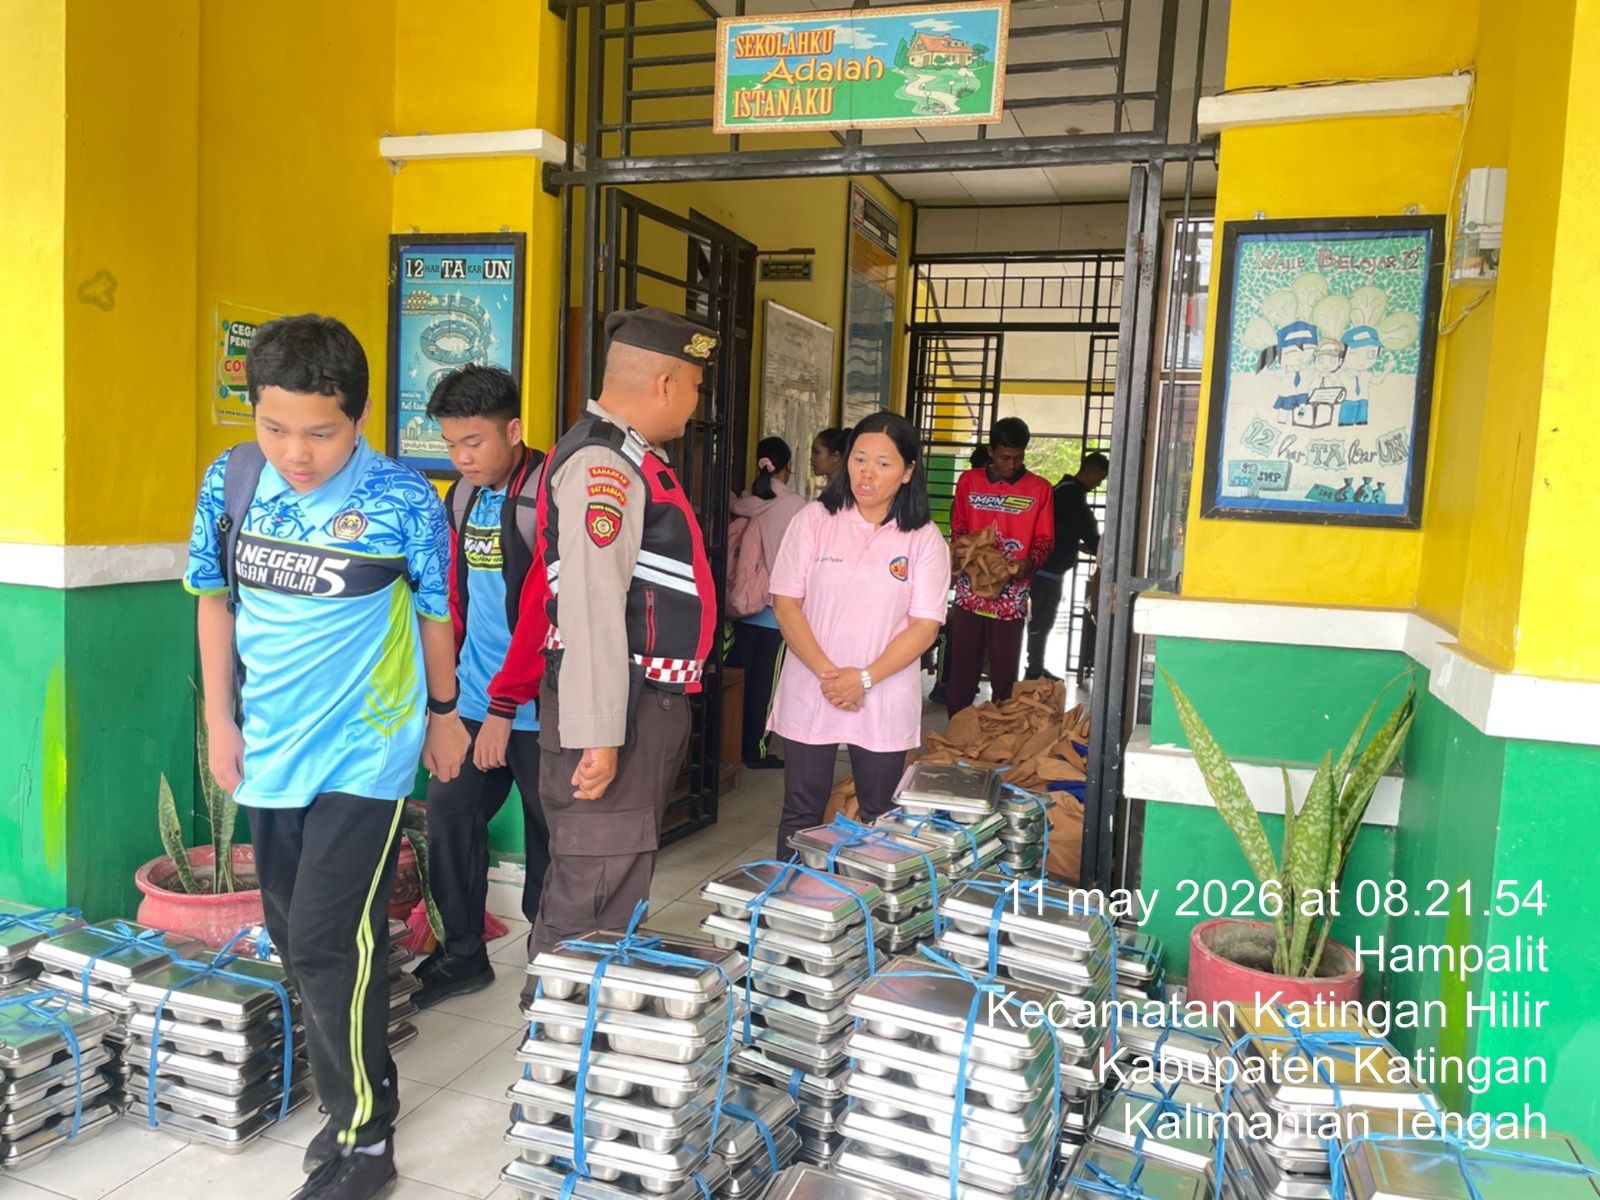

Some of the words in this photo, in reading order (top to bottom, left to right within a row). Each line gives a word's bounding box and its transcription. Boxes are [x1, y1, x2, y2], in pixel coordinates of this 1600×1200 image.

[734, 29, 836, 59] SEKOLAHKU
[761, 54, 885, 86] Adalah
[732, 86, 836, 120] ISTANAKU
[405, 259, 424, 278] 12
[441, 259, 466, 278] TA
[483, 260, 512, 279] UN
[231, 323, 257, 338] CEGA
[1243, 421, 1275, 452] 12
[1310, 443, 1346, 468] TA
[1378, 432, 1410, 465] UN
[968, 494, 1006, 506] SMPN
[241, 543, 320, 576] NEGERI
[312, 557, 351, 597] 5
